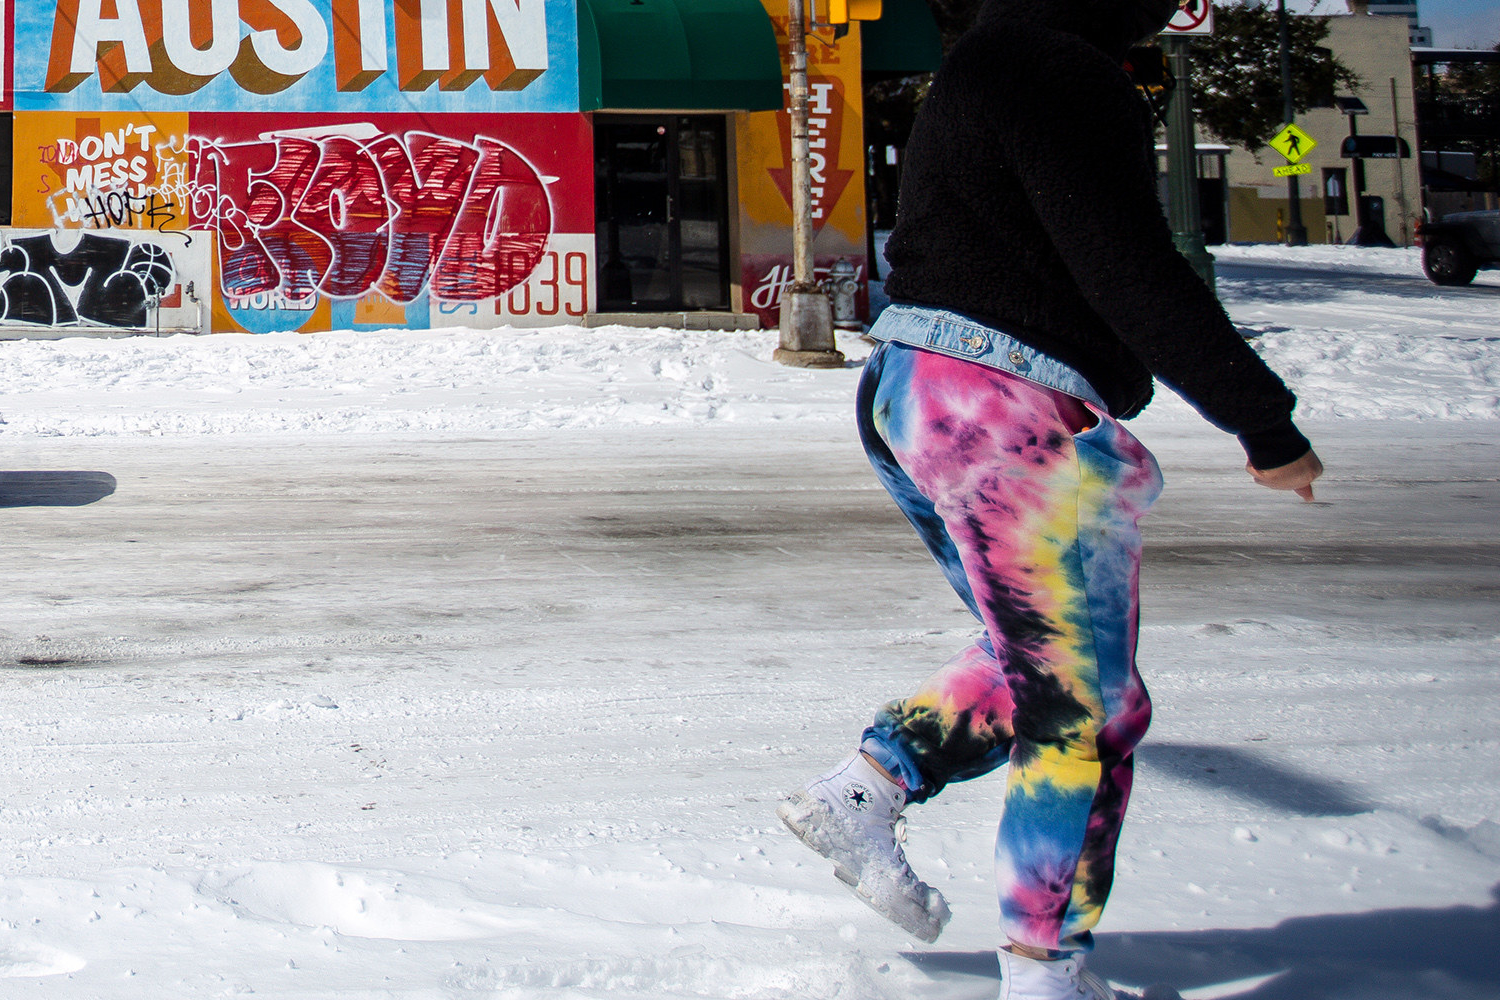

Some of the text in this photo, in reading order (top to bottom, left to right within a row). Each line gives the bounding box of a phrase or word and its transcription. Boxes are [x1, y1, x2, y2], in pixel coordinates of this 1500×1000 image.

[57, 123, 157, 165] DON'T
[66, 155, 147, 193] MESS
[1276, 165, 1309, 176] AHEAD
[228, 286, 317, 311] WORLD
[495, 251, 588, 317] 1839
